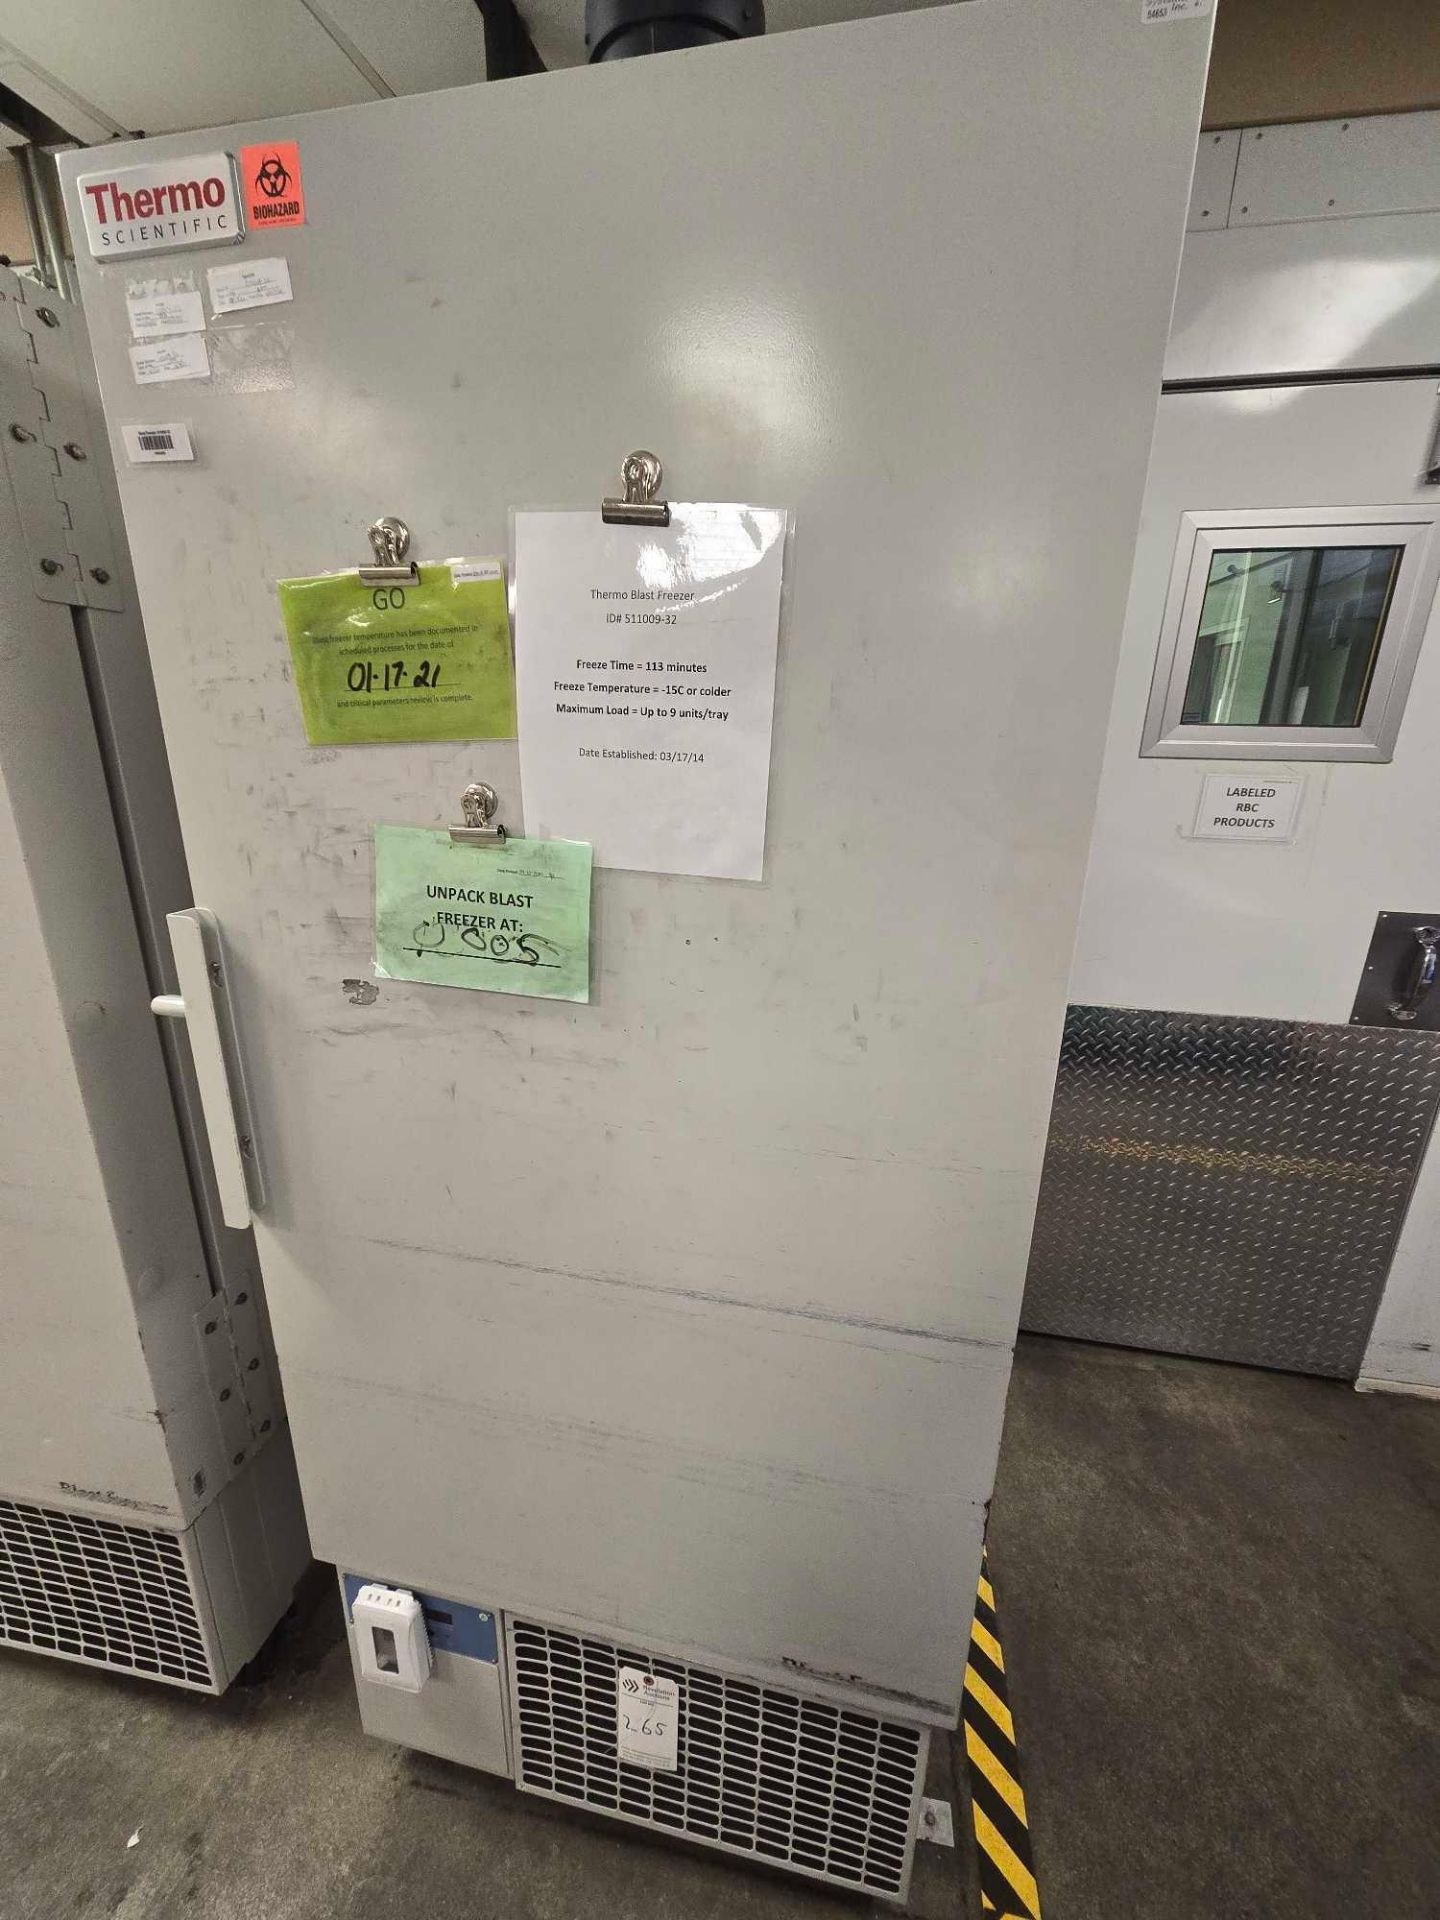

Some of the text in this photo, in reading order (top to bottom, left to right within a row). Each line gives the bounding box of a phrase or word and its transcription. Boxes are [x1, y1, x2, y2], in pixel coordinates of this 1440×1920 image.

[85, 177, 226, 224] Thermo
[253, 201, 300, 220] BIOHAZARD
[102, 214, 228, 246] SCIENTIFIC
[373, 588, 405, 610] GO
[591, 589, 695, 601] Thermo Blast Freezer
[606, 613, 677, 625] ID# 511009-32
[427, 624, 470, 637] documented
[430, 640, 445, 649] date
[576, 659, 608, 670] Freeze
[610, 660, 635, 671] Time
[645, 661, 664, 672] 113
[666, 662, 708, 673] minutes
[554, 681, 586, 692] Freeze
[587, 682, 651, 695] Temperature
[661, 685, 684, 695] -15C
[686, 687, 697, 696] or
[699, 686, 732, 697] colder
[556, 703, 604, 715] Maximum
[606, 705, 630, 716] Load
[640, 706, 654, 718] Up
[657, 707, 668, 717] to
[669, 707, 677, 717] 9
[679, 708, 729, 722] units/tray
[579, 748, 705, 763] Date Established: 03/17/14
[1226, 787, 1276, 798] LABELED
[1236, 802, 1260, 813] RBC
[1213, 817, 1276, 829] PRODUCTS
[426, 885, 534, 908] UNPACK BLAST
[437, 911, 523, 933] FREEZER AT:
